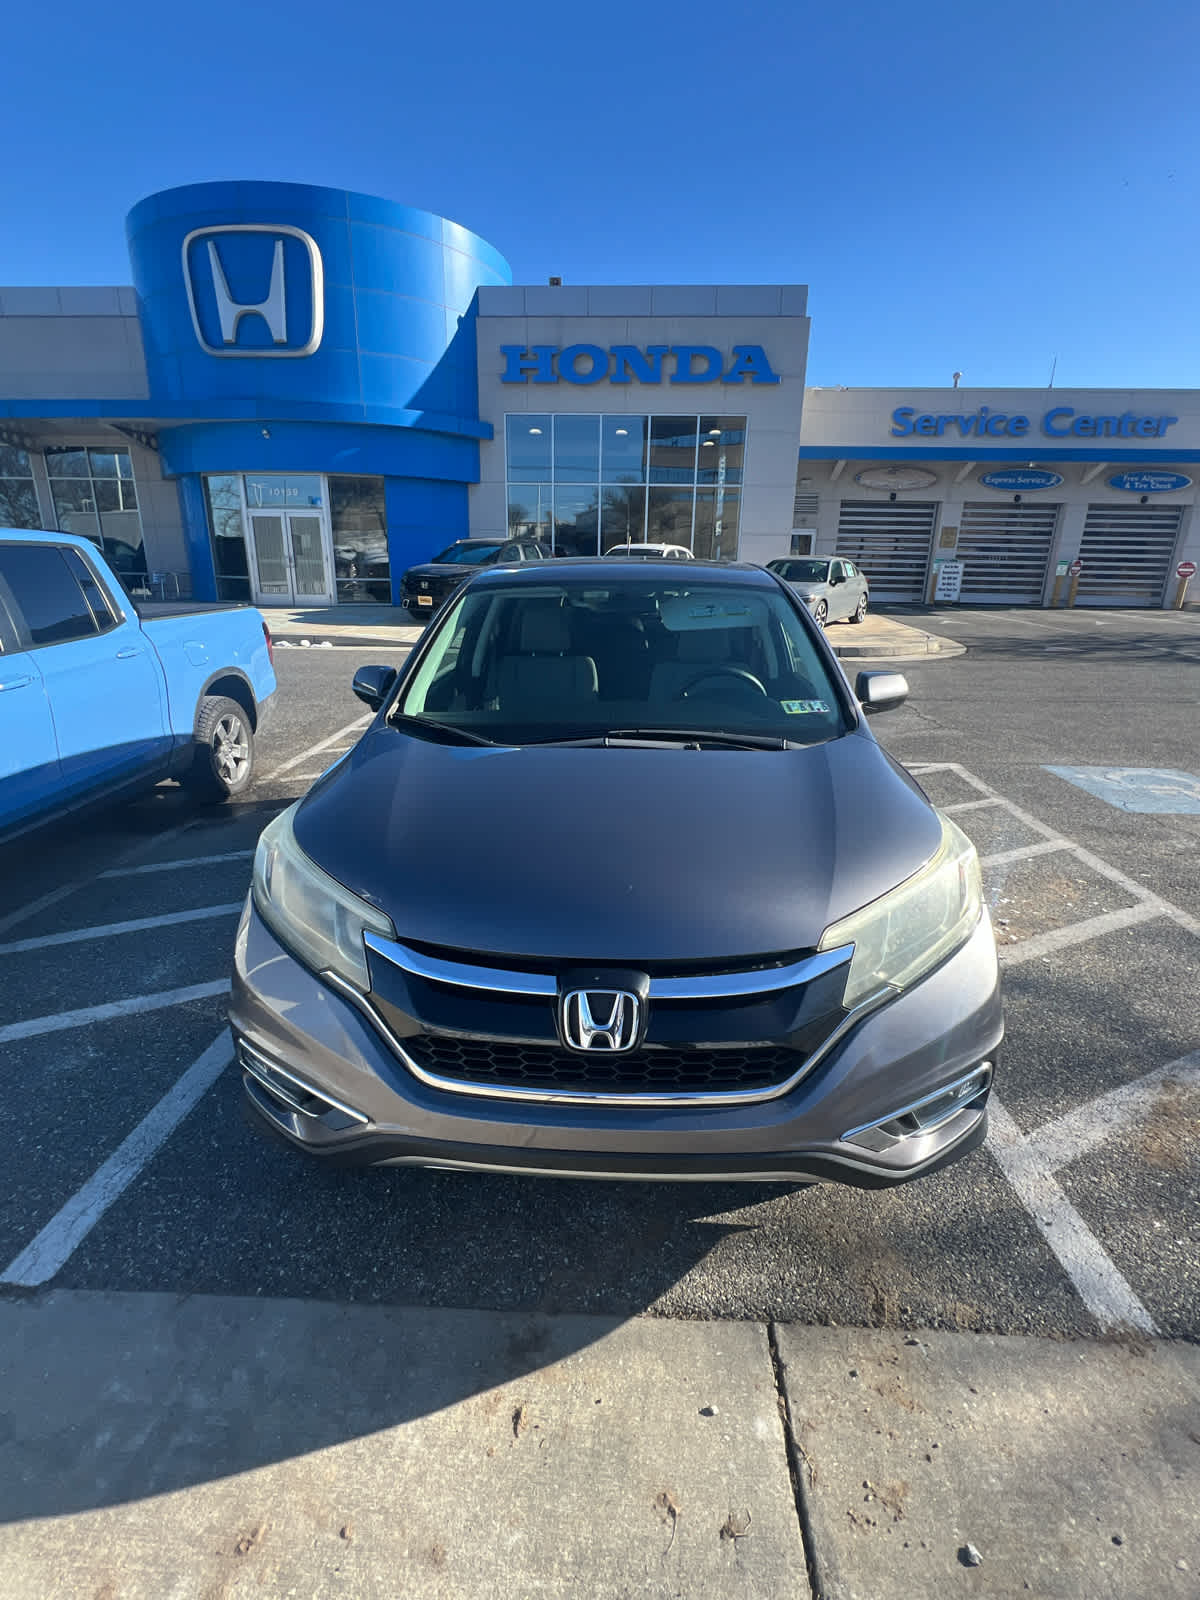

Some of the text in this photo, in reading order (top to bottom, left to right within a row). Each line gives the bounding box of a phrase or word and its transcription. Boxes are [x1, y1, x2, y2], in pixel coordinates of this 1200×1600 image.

[500, 344, 780, 385] HONDA
[891, 406, 1179, 439] Service Center
